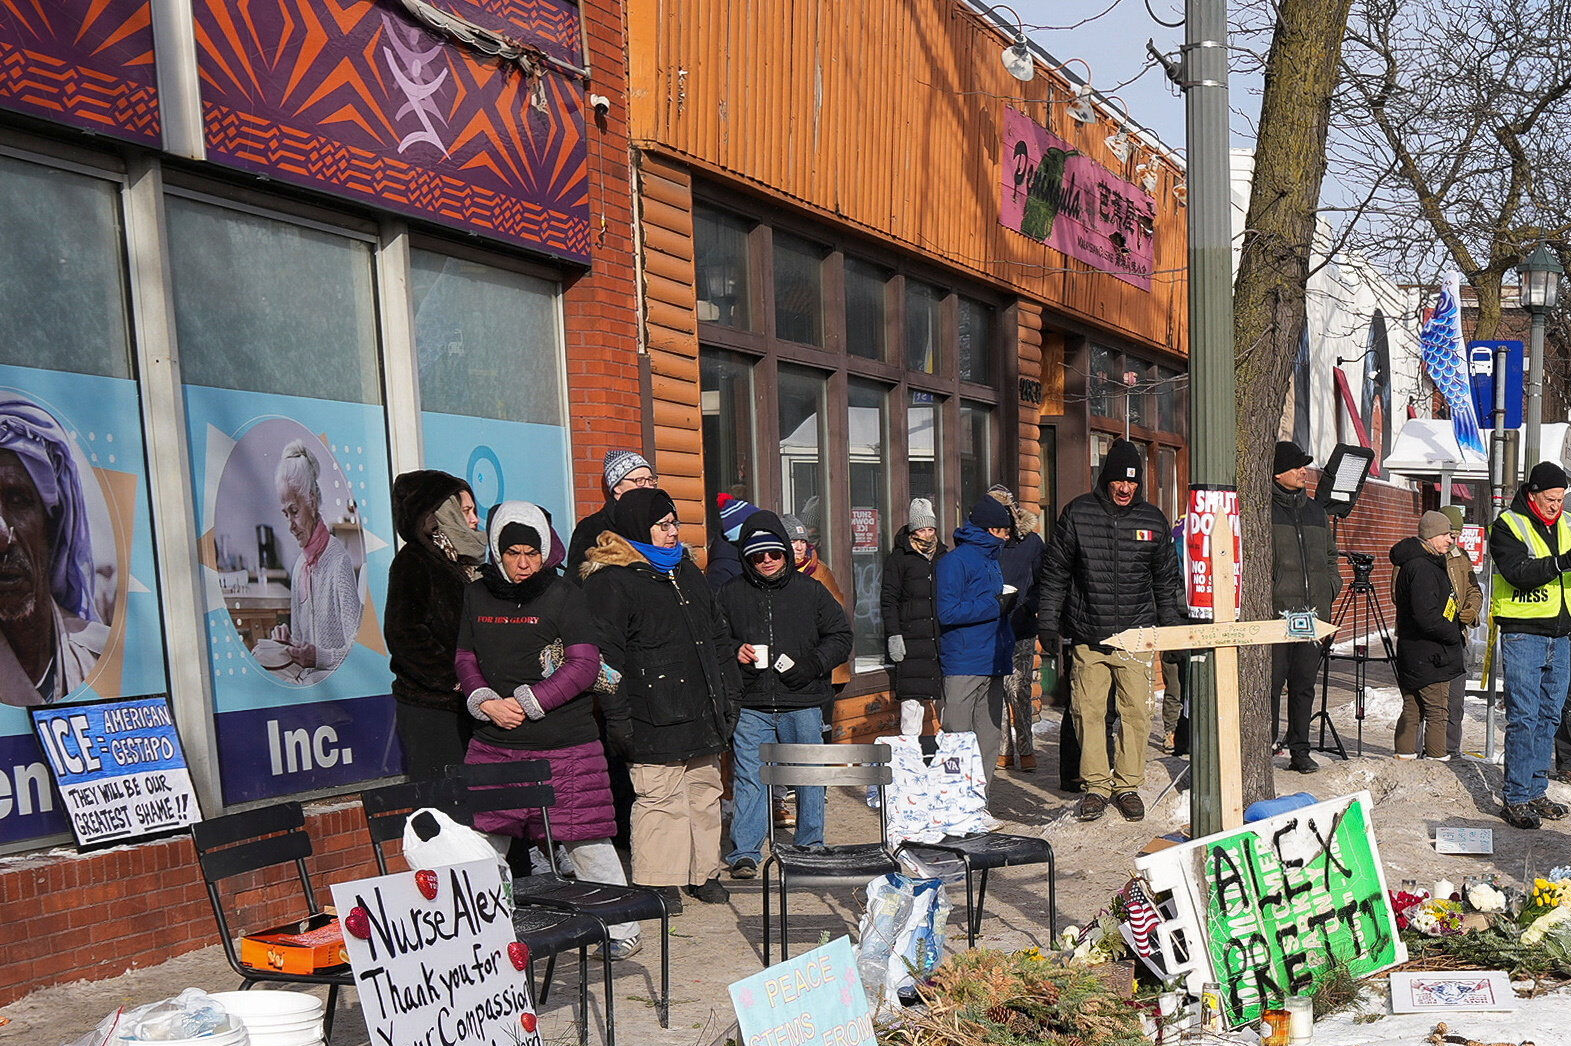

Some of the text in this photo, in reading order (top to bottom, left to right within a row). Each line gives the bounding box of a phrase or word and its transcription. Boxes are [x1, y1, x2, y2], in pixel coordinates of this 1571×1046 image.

[1195, 490, 1237, 513] SHUT
[1192, 562, 1206, 574] NO
[1194, 575, 1205, 584] NO
[1512, 589, 1549, 602] PRESS
[477, 616, 491, 624] FOR
[510, 616, 539, 624] GLORY
[38, 714, 102, 777] ICE
[103, 704, 173, 734] AMERICAN
[110, 736, 174, 766] GESTAPO
[266, 719, 353, 776] Inc.
[944, 759, 960, 772] VA
[68, 774, 172, 808] THEY WILL BE OUR
[74, 805, 132, 836] GREATEST
[1213, 798, 1358, 918] ALEX
[355, 868, 509, 961] Nurse Alex
[360, 962, 440, 1019] Thank
[440, 964, 475, 1008] you
[763, 955, 836, 1008] PEACE
